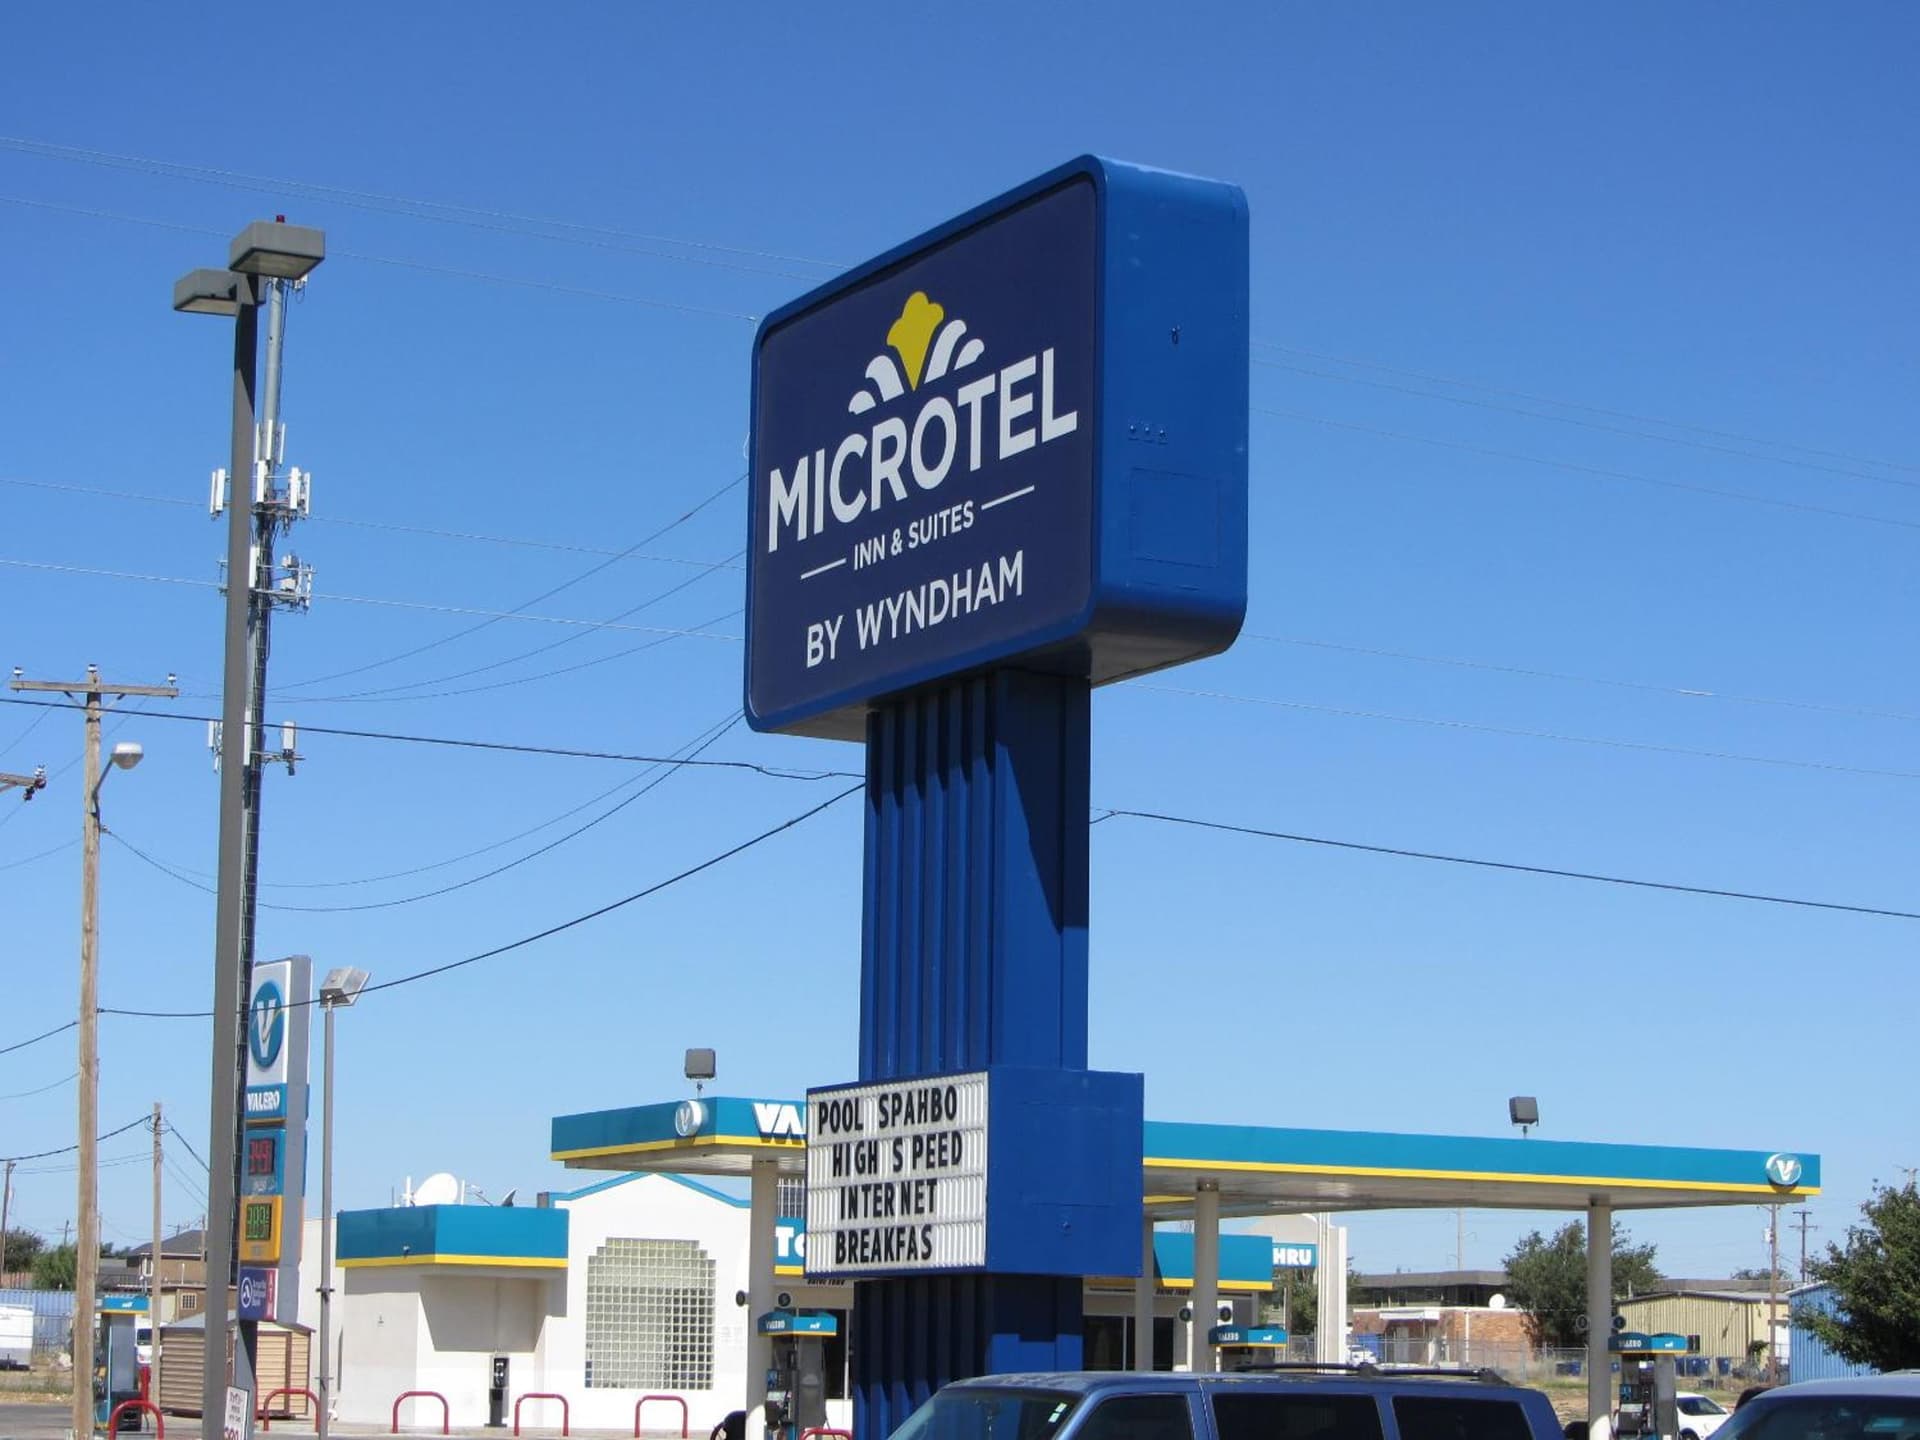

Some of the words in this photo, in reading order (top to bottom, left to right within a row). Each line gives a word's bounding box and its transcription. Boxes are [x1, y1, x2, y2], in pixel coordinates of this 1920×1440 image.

[768, 347, 1079, 553] MICROTEL
[853, 535, 886, 571] INN
[890, 528, 903, 555] &
[908, 500, 975, 549] SUITES
[806, 615, 844, 669] BY
[856, 550, 1024, 650] WYNDHAM
[247, 1091, 281, 1112] VALERO
[753, 1103, 807, 1135] VA
[818, 1098, 864, 1135] POOL
[878, 1085, 958, 1129] SPAHBO
[832, 1140, 878, 1177] HIGH
[835, 1223, 933, 1265] BREAKFAS
